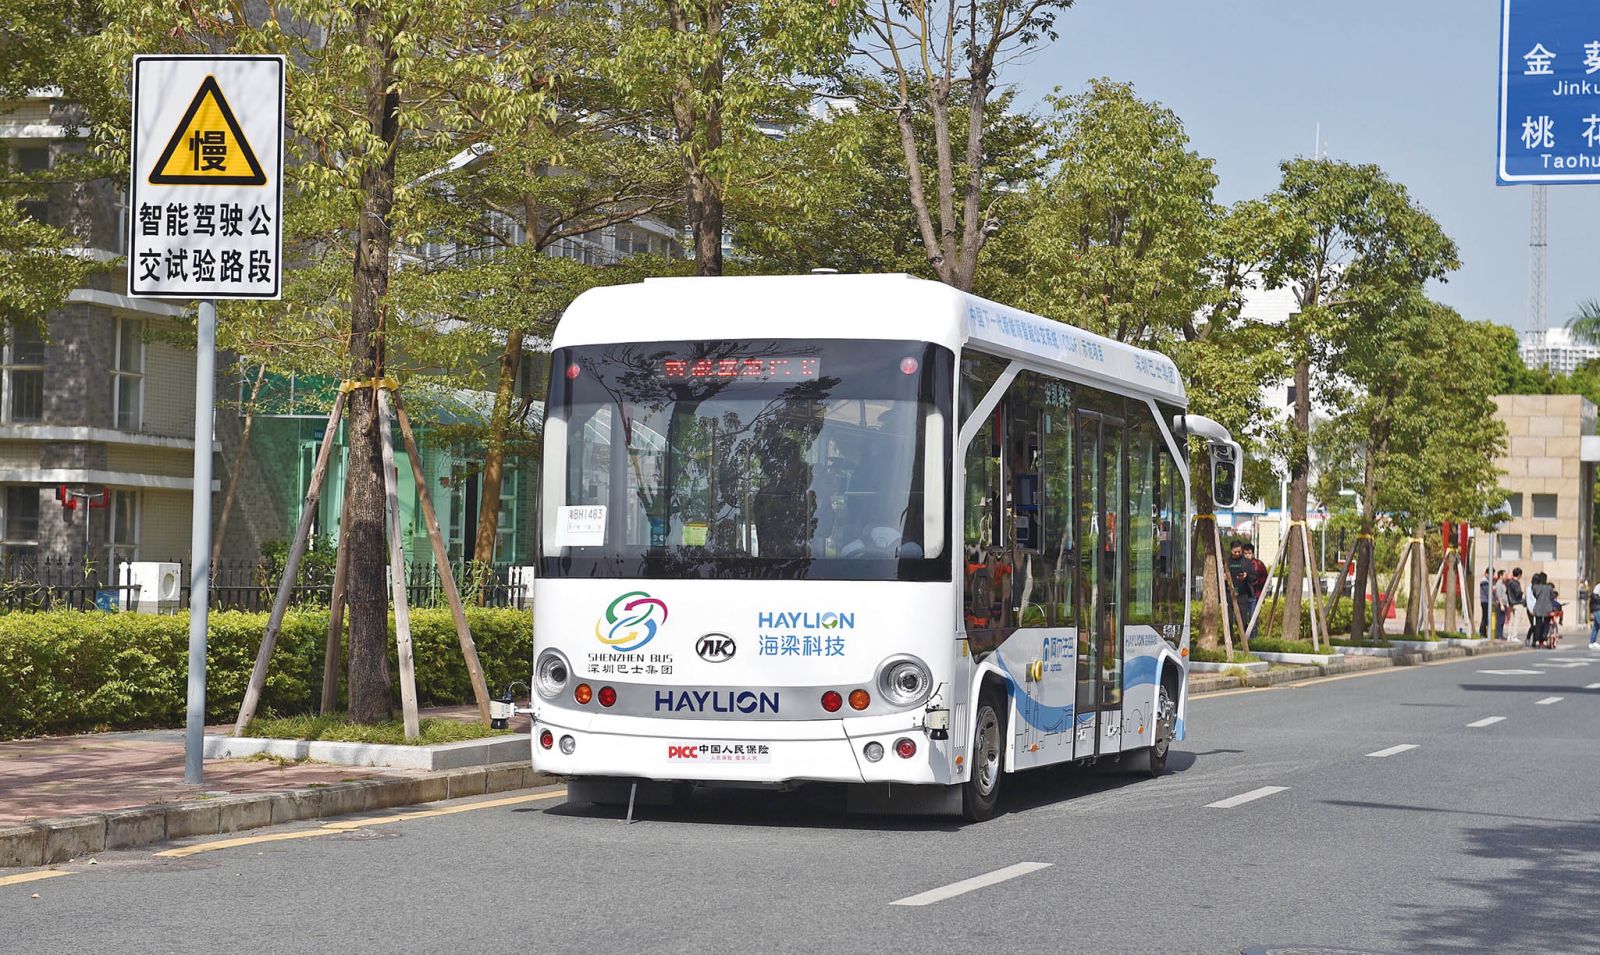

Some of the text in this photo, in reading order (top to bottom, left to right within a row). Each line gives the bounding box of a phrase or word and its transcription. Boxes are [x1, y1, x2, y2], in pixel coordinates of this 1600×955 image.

[189, 130, 227, 172] 慢
[1540, 153, 1600, 169] Taohu
[139, 202, 272, 237] 智能驾驶公
[139, 248, 272, 283] 交试验路段
[758, 611, 855, 630] HAYLION
[758, 634, 846, 657] 海梁科技
[588, 653, 673, 663] SHENZHEN BUS
[588, 663, 673, 675] 深圳巴士集团
[655, 691, 780, 713] HAYLION
[668, 744, 769, 758] PICC 中国人民保险
